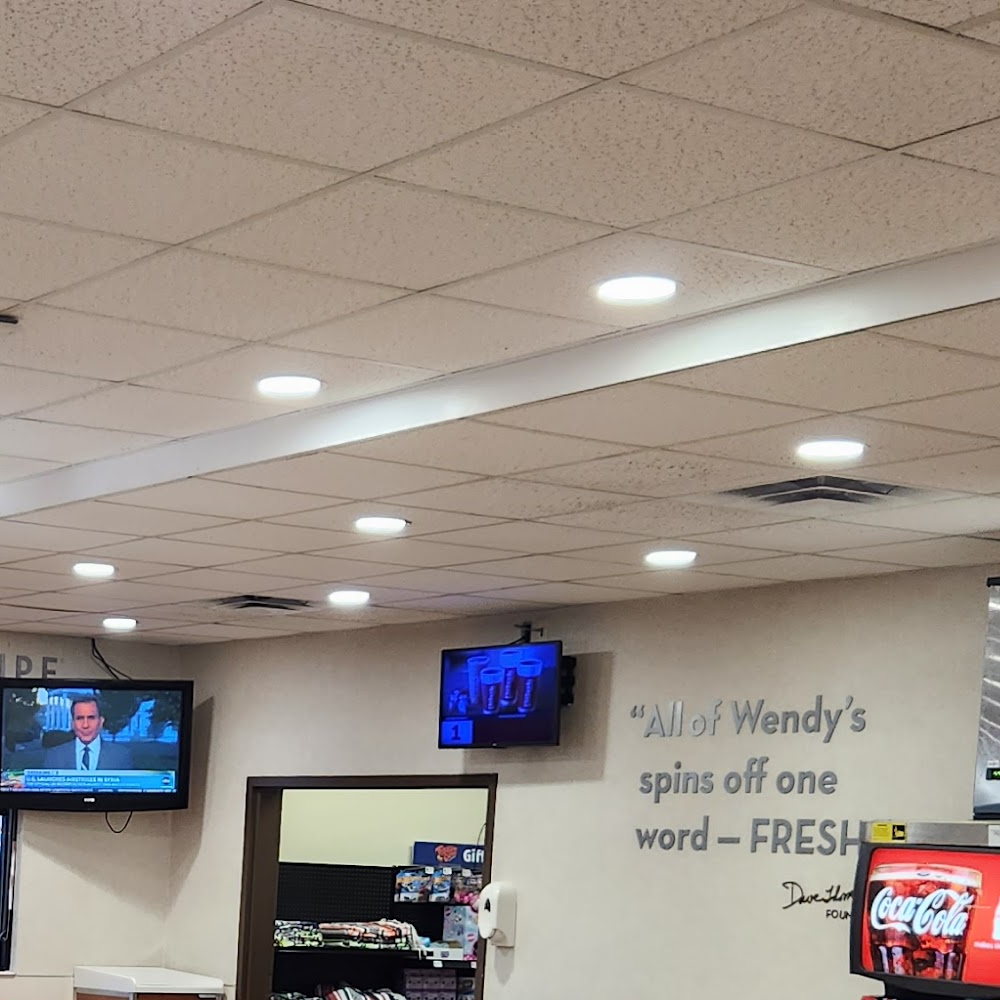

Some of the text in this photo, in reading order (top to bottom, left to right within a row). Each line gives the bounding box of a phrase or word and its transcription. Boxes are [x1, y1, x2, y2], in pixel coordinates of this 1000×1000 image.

[451, 724, 461, 741] 1
[630, 694, 867, 744] “All of Wendy’s
[639, 756, 838, 804] spins off one
[635, 815, 710, 852] word
[826, 909, 852, 920] FOUN
[870, 886, 975, 937] Coca-Cola
